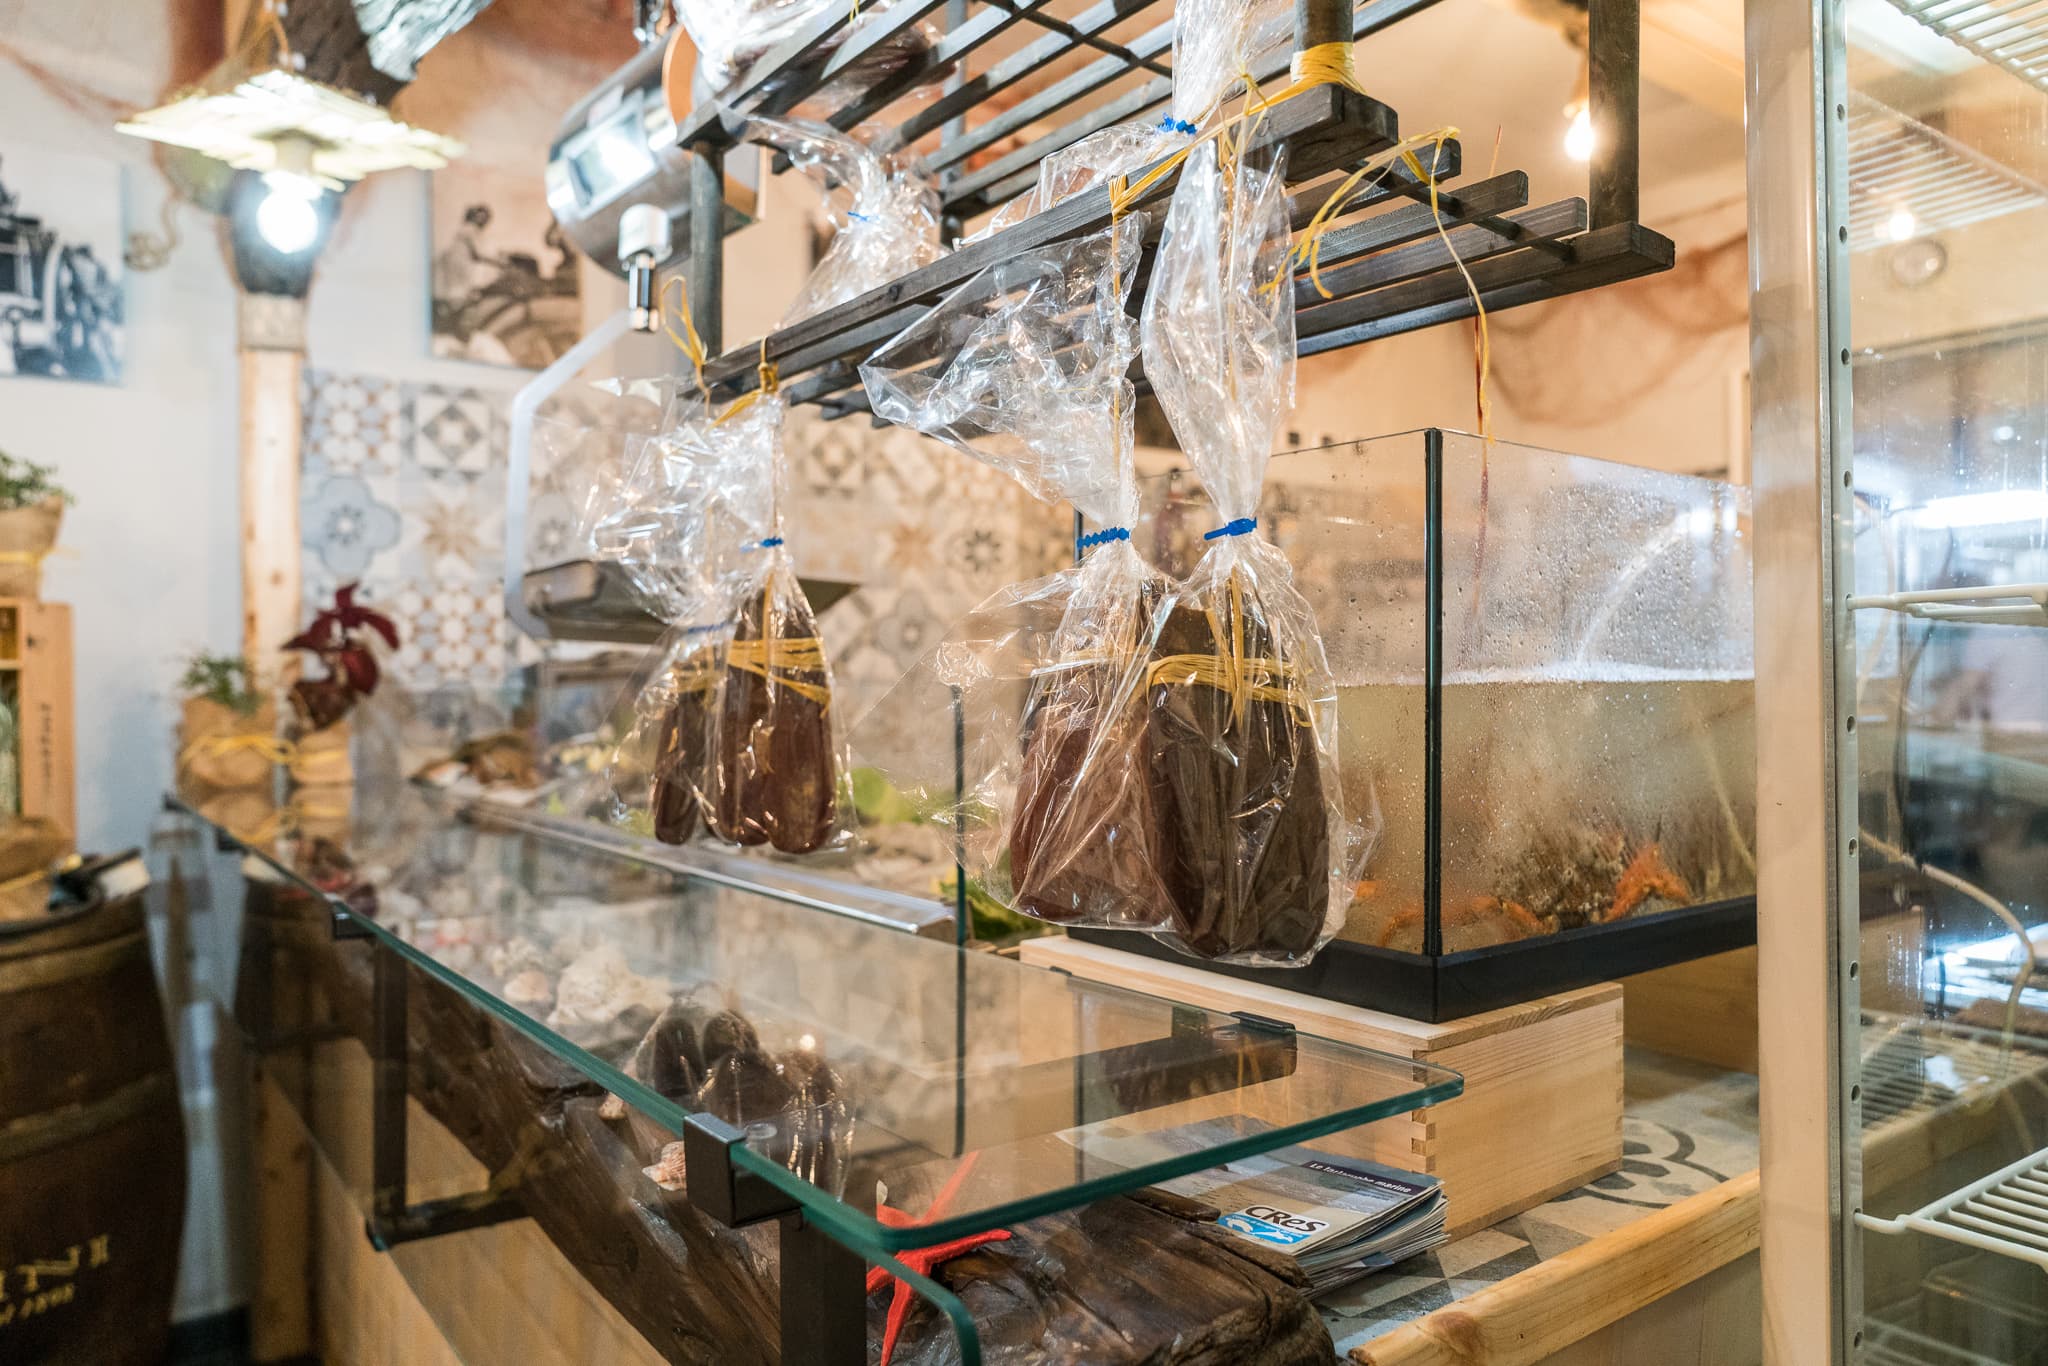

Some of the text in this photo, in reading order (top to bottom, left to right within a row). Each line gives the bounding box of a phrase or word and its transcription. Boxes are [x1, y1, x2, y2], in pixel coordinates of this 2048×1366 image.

[1310, 1162, 1324, 1171] Le
[1374, 1180, 1412, 1193] marine
[1245, 1206, 1326, 1232] CReS
